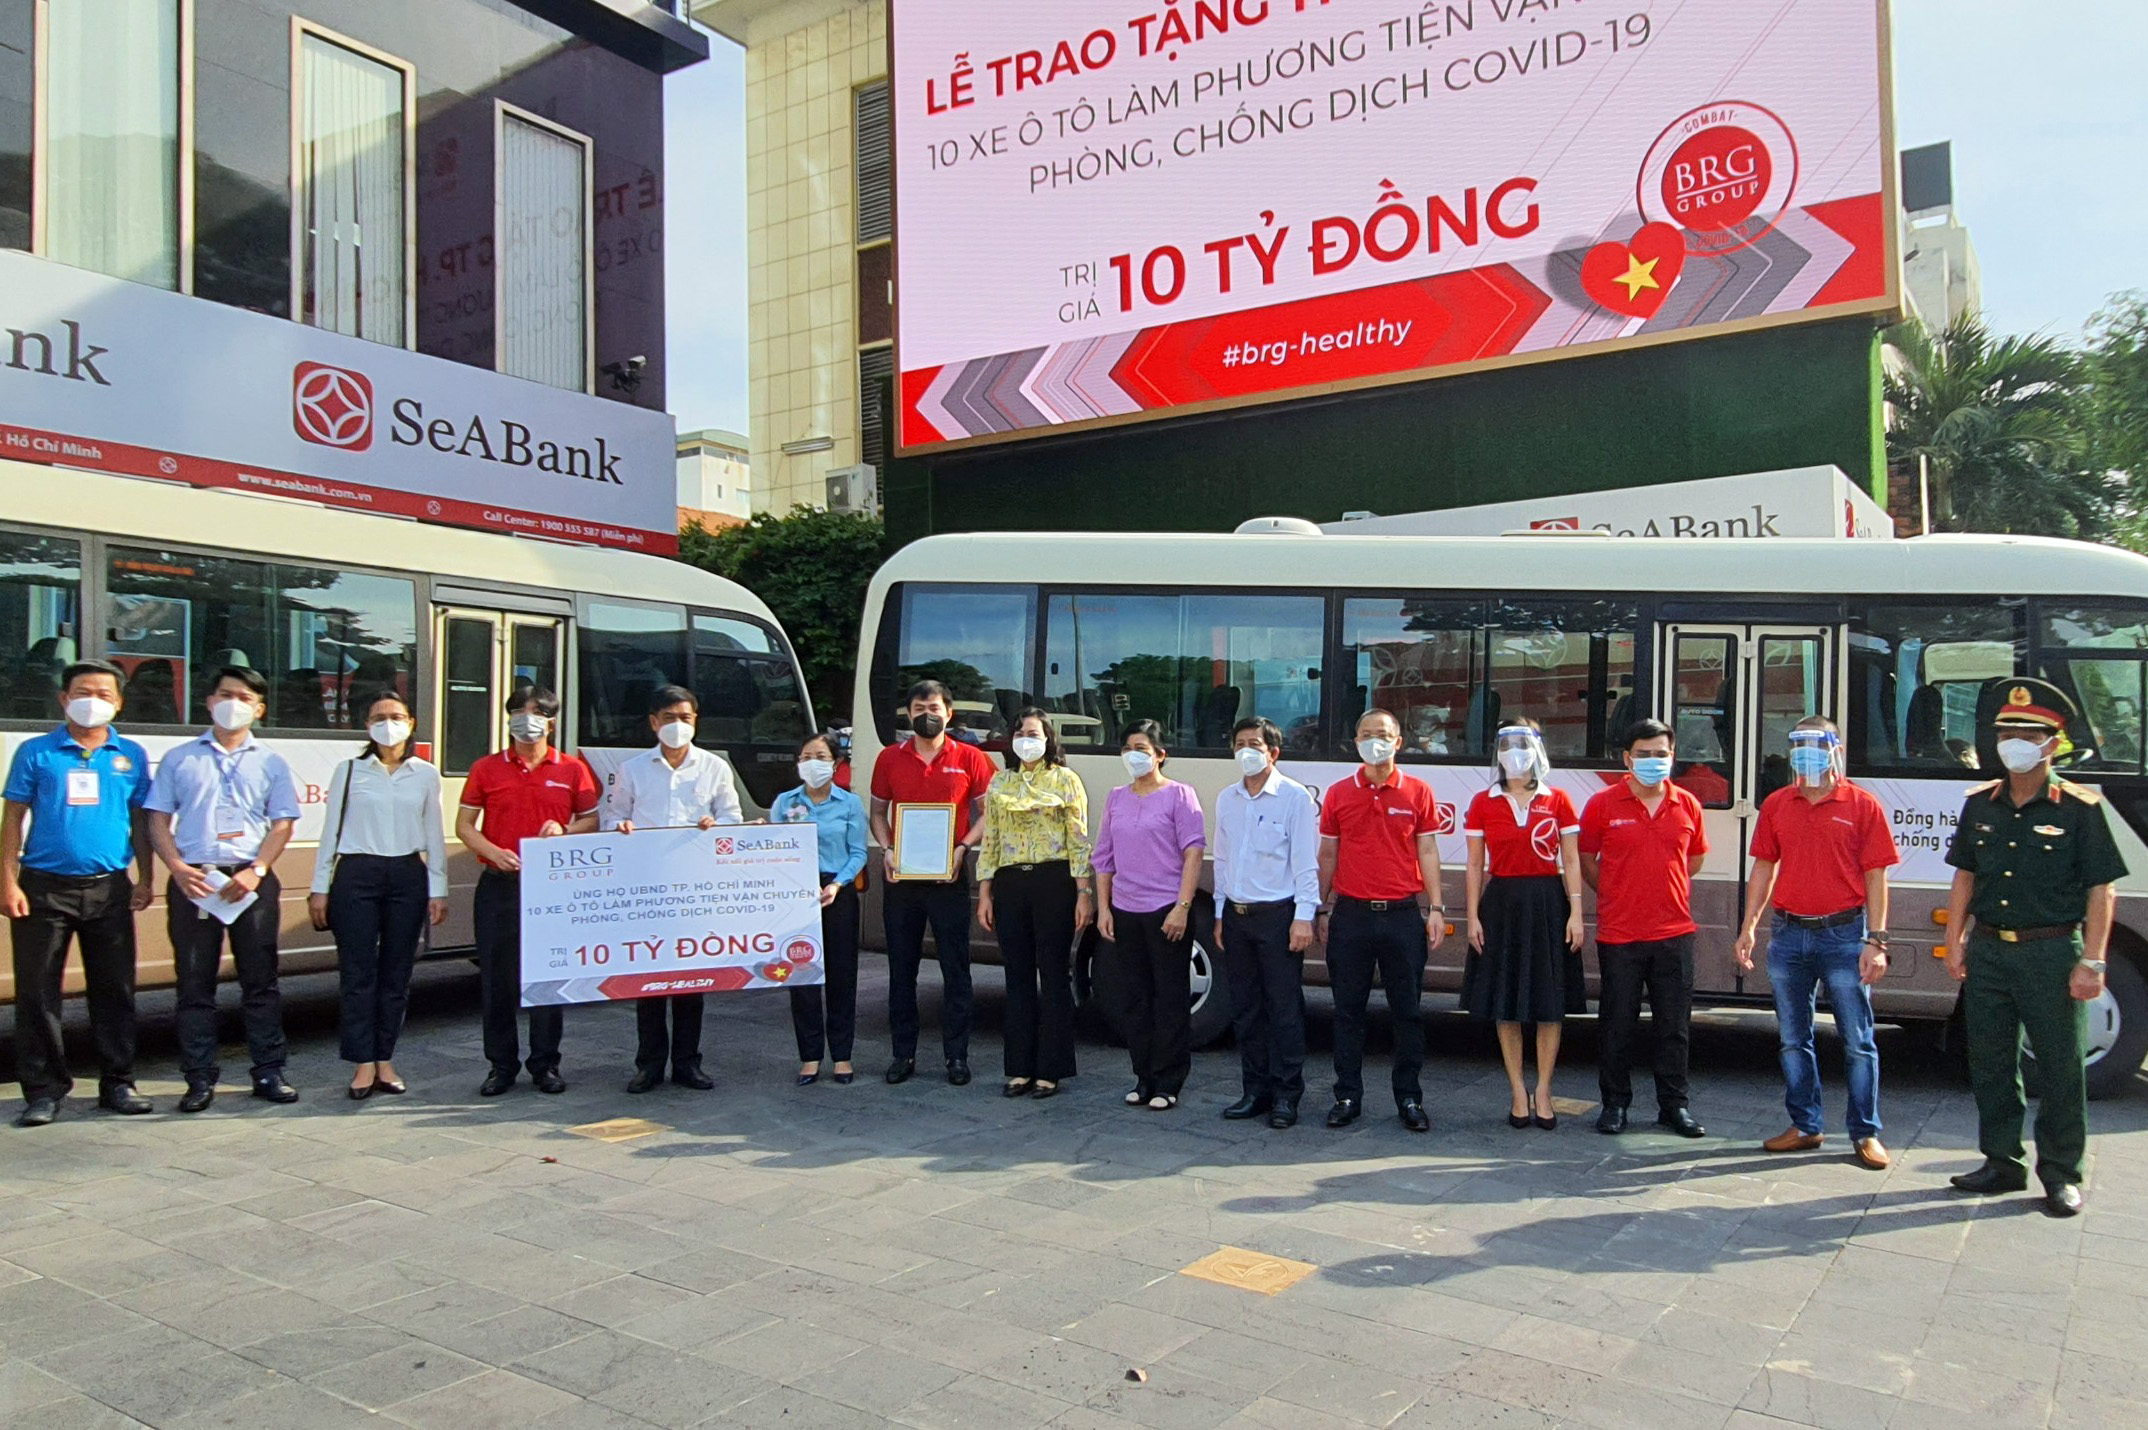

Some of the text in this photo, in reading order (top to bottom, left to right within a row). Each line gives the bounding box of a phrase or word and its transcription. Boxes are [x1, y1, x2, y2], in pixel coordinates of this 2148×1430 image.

[926, 51, 975, 115] LỄ
[986, 29, 1117, 97] TRAO
[927, 139, 959, 170] 10
[969, 125, 1008, 160] XE
[1018, 111, 1043, 146] Ô
[1052, 96, 1095, 138] TÔ
[1107, 79, 1179, 124] LÀM
[1194, 30, 1365, 102] PHƯƠNG
[1379, 1, 1473, 51] TIỆN
[1029, 13, 1652, 194] PHÒNG, CHỐNG DỊCH COVID-19
[1675, 145, 1755, 193] BRG
[1676, 180, 1759, 213] GROUP
[1109, 176, 1540, 314] 10 TỶ ĐỒNG
[1059, 261, 1098, 289] TRỊ
[1058, 292, 1101, 324] GIÁ
[1221, 318, 1413, 368] #brg-healthy
[62, 441, 103, 461] Minh
[391, 398, 624, 485] SeABank
[237, 473, 373, 503] www.seabank.com.vn
[483, 510, 502, 522] Call
[504, 514, 539, 528] Center:
[541, 519, 564, 532] 1900
[549, 846, 613, 868] BRG
[737, 838, 799, 851] SeABank
[548, 868, 614, 881] GROUP
[631, 884, 667, 895] UBND
[672, 882, 690, 893] TP.
[743, 879, 775, 889] MINH
[527, 906, 542, 917] 10
[545, 904, 563, 915] XE
[680, 905, 712, 918] DỊCH
[716, 903, 775, 915] COVID-19
[574, 943, 610, 966] 10
[621, 934, 664, 962] TỶ
